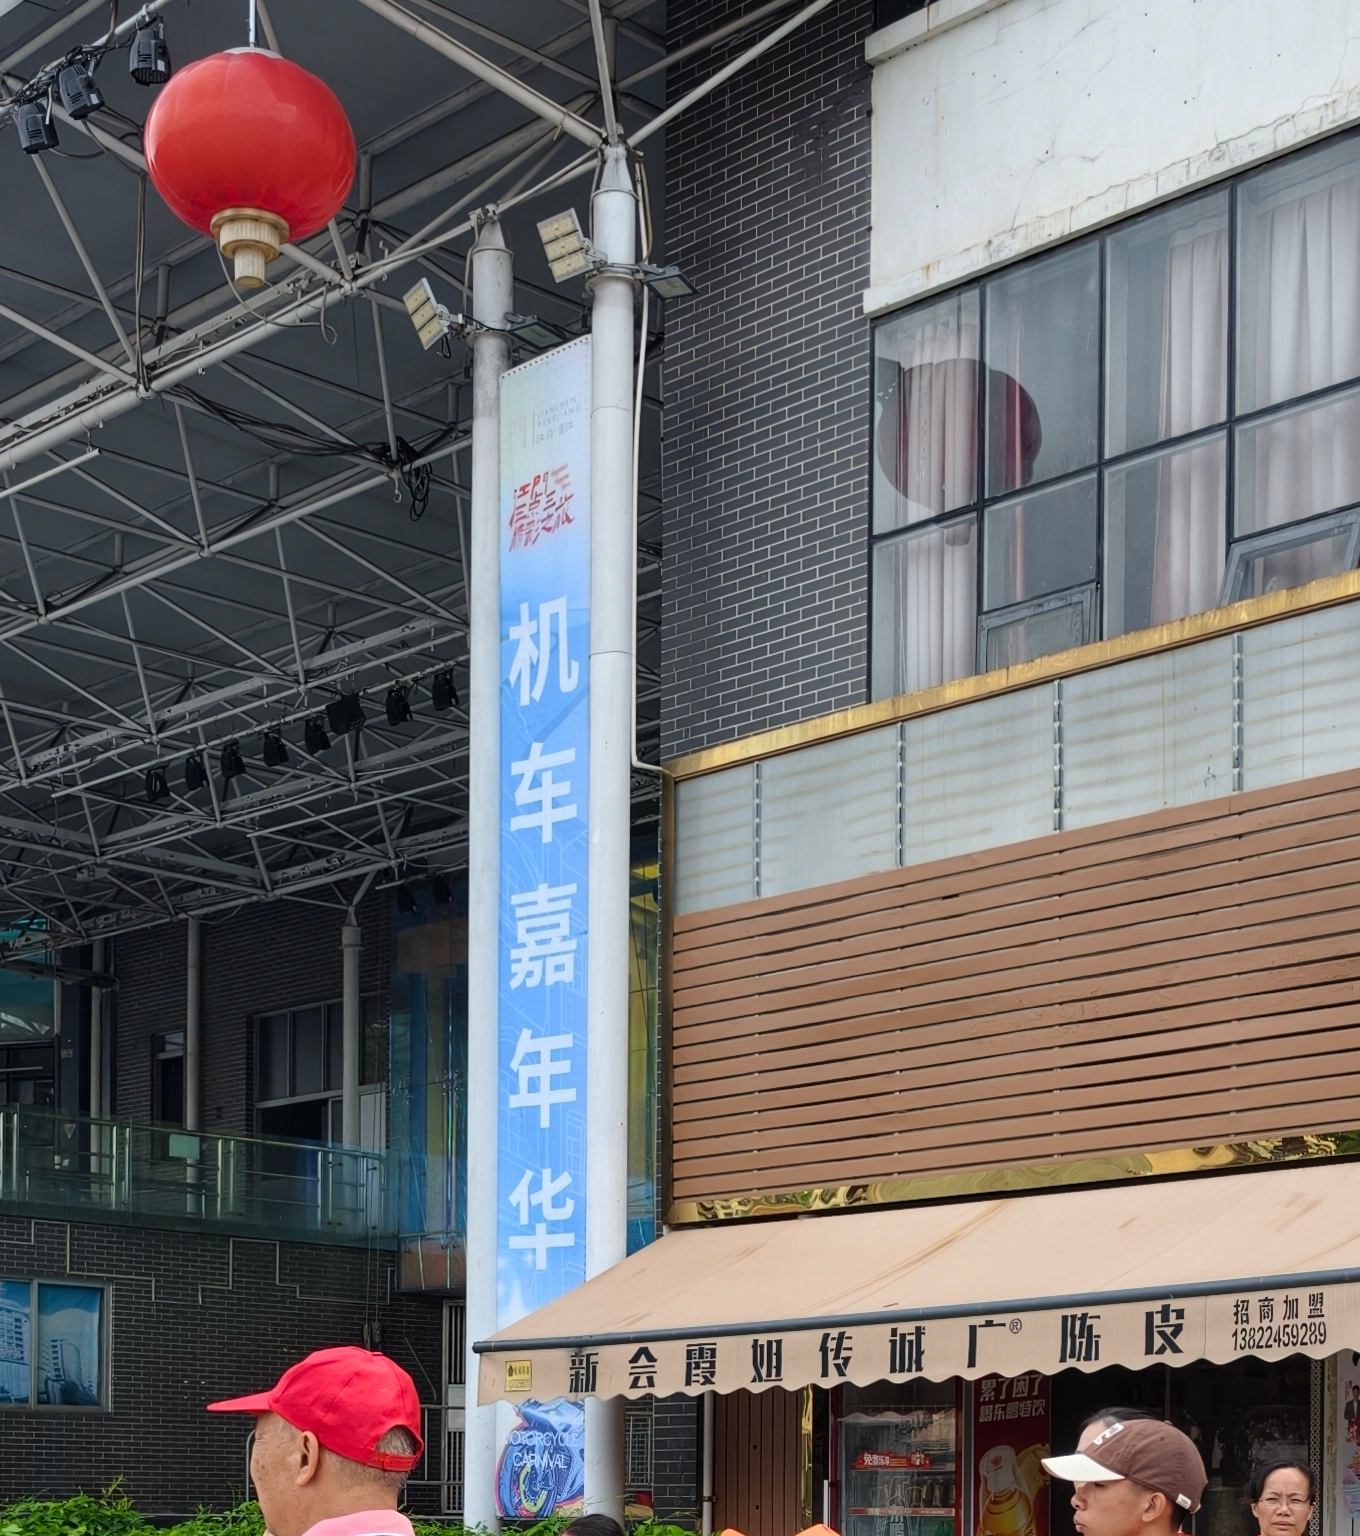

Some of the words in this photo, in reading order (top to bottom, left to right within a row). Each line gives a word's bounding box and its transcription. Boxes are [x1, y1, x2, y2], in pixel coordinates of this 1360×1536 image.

[508, 595, 579, 1271] 机车嘉年华
[1233, 1292, 1325, 1325] 招商加盟
[1231, 1321, 1327, 1351] 13822459289
[979, 1374, 1044, 1402] 累了困了
[513, 1451, 568, 1469] CARNIVAL
